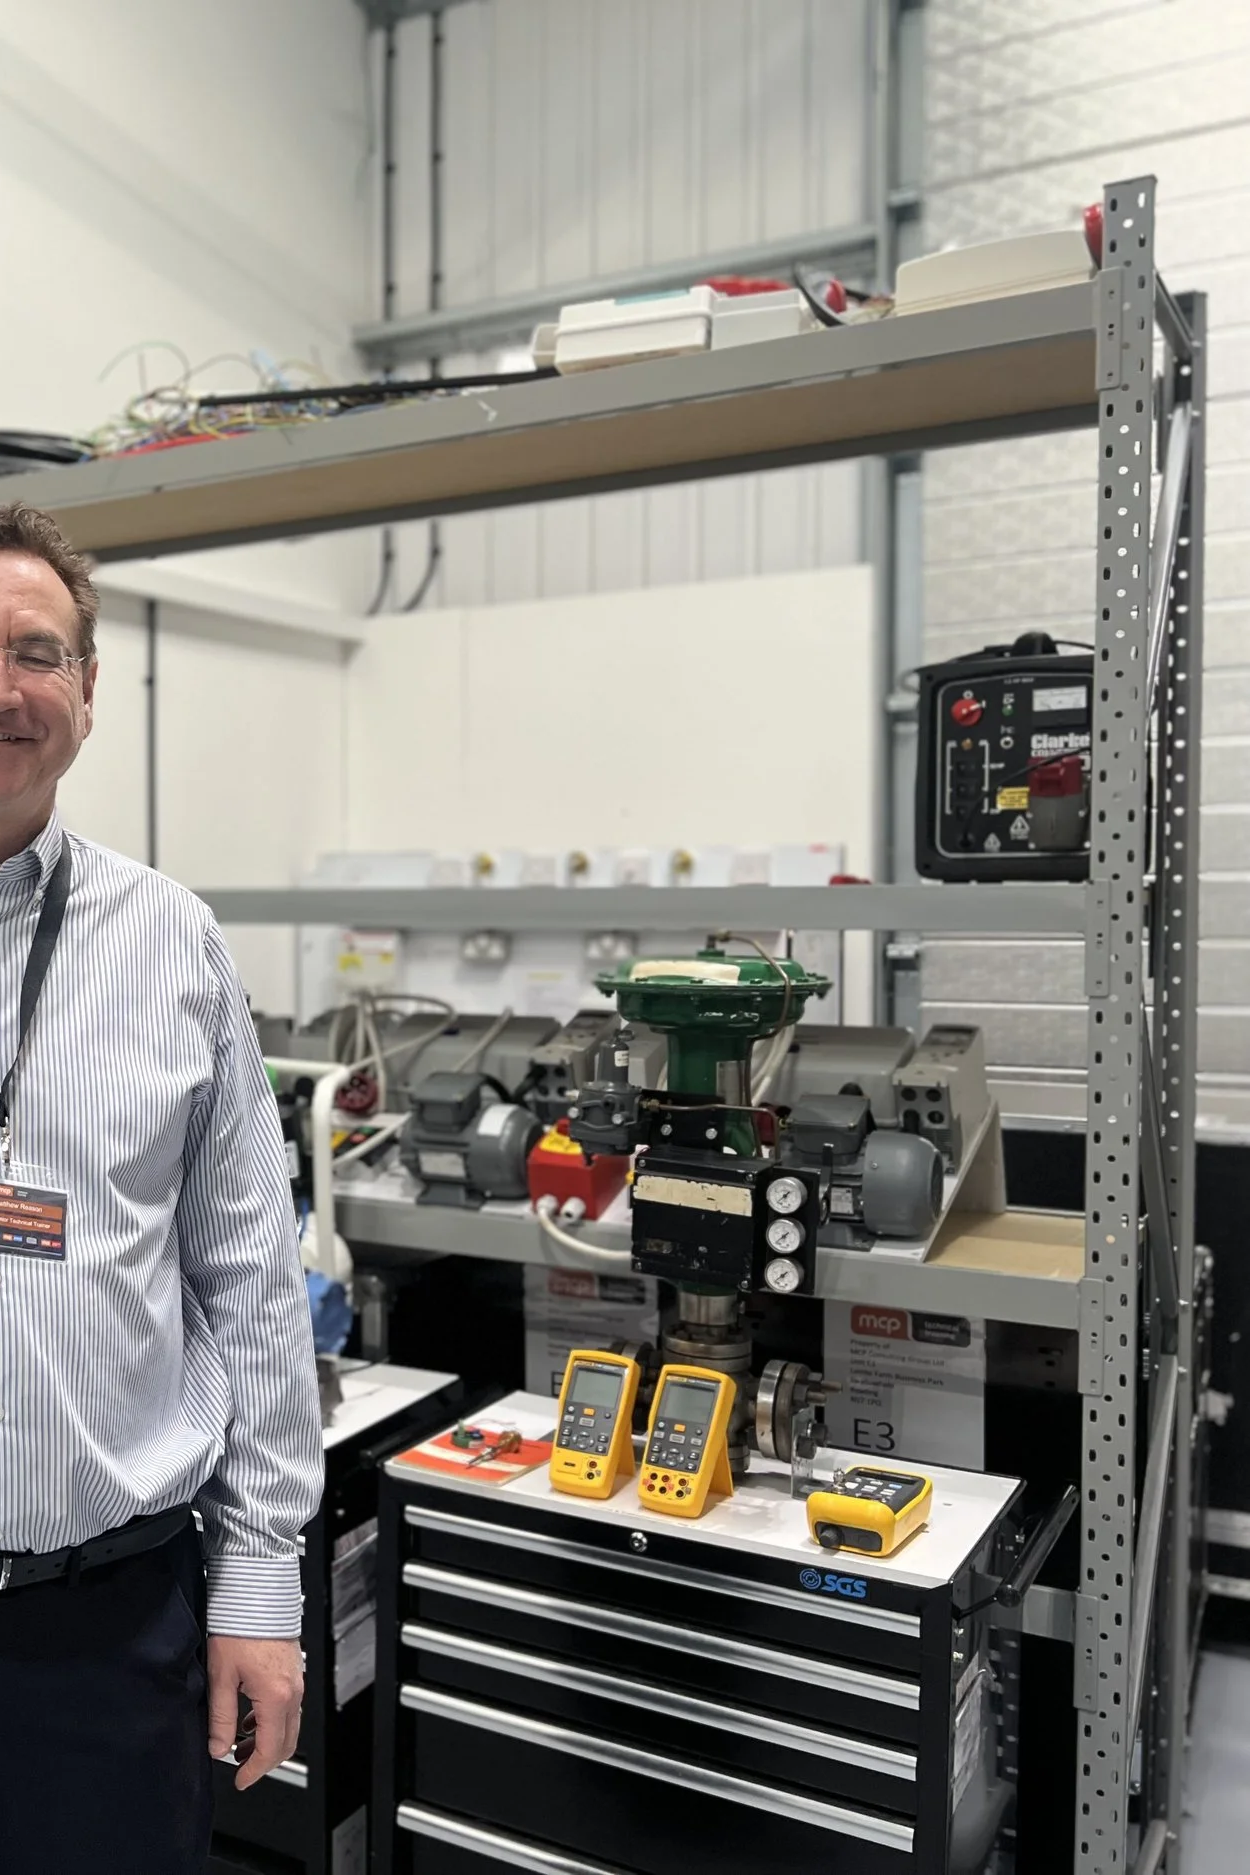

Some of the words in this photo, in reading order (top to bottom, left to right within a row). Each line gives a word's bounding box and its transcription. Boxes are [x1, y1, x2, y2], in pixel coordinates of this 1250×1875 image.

[1031, 732, 1091, 749] Clarke
[858, 1313, 902, 1335] mcp
[853, 1417, 896, 1451] E3
[821, 1574, 867, 1598] SGS
